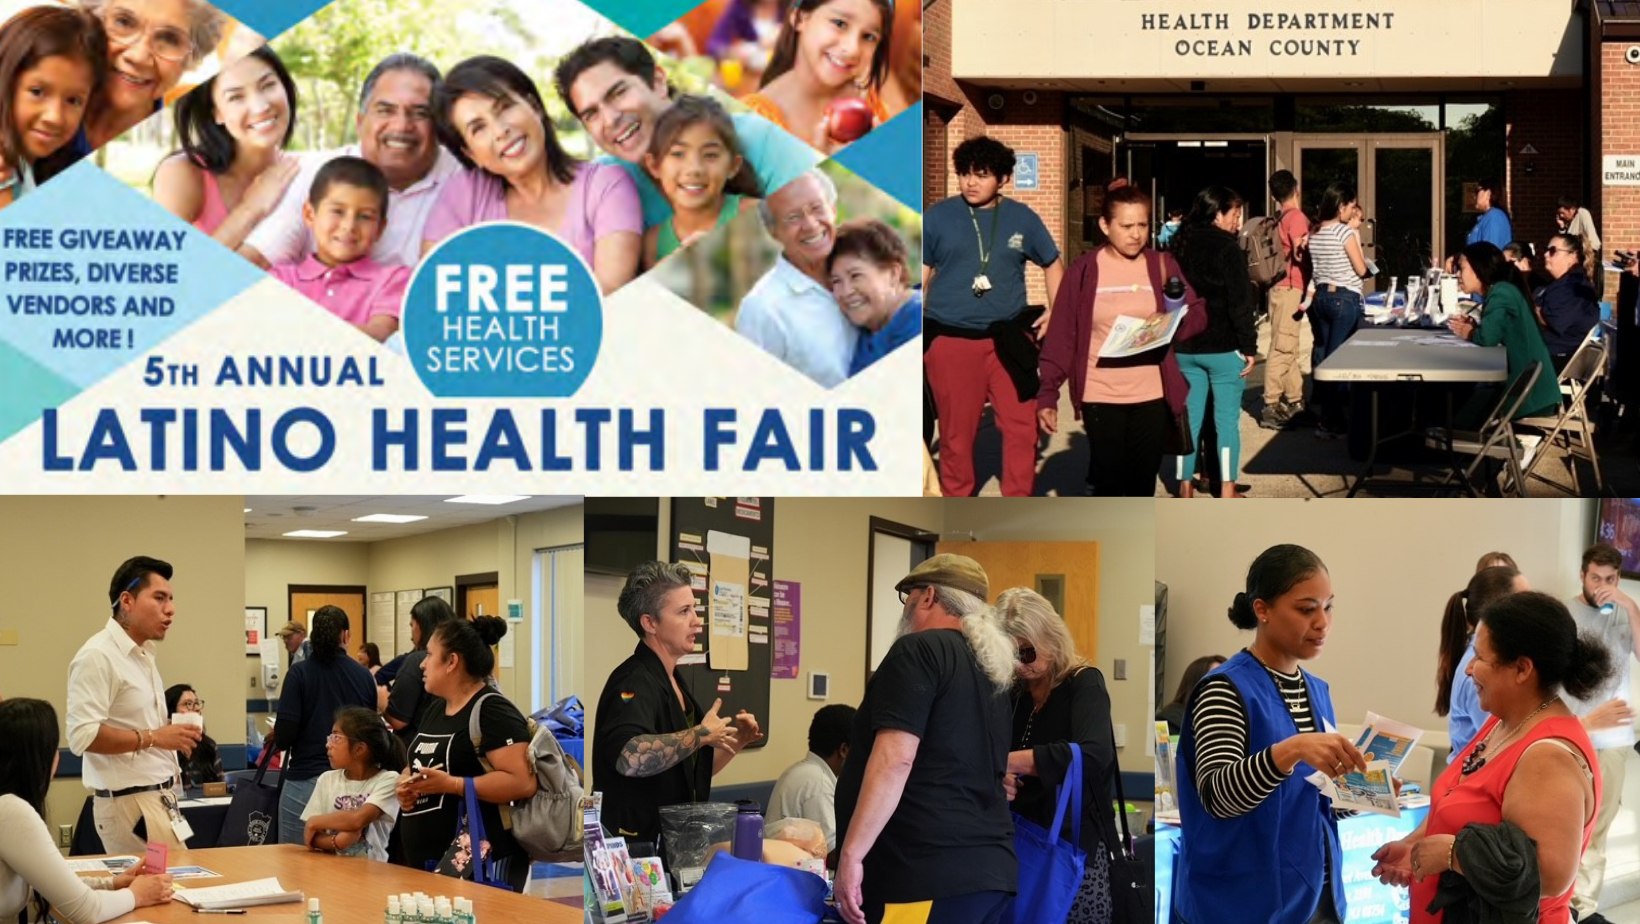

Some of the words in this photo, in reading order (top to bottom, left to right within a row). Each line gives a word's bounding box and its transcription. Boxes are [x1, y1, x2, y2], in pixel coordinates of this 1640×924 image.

[1141, 13, 1229, 30] HEALTH
[1248, 13, 1395, 30] DEPARTMENT
[1175, 39, 1252, 56] OCEAN
[1269, 39, 1360, 56] COUNTY
[1616, 159, 1635, 168] MAIN
[4, 228, 54, 250] FREE
[59, 229, 187, 252] GIVEAWAY
[5, 262, 81, 286] PRIZES,
[88, 263, 178, 284] DIVERSE
[436, 264, 568, 312] FREE
[6, 295, 117, 317] VENDORS
[122, 296, 176, 317] AND
[443, 315, 559, 341] HEALTH
[143, 356, 199, 387] 5TH
[215, 356, 385, 386] ANNUAL
[426, 346, 575, 373] SERVICES
[42, 406, 336, 472] LATINO
[372, 408, 665, 472] HEALTH
[703, 408, 878, 472] FAIR
